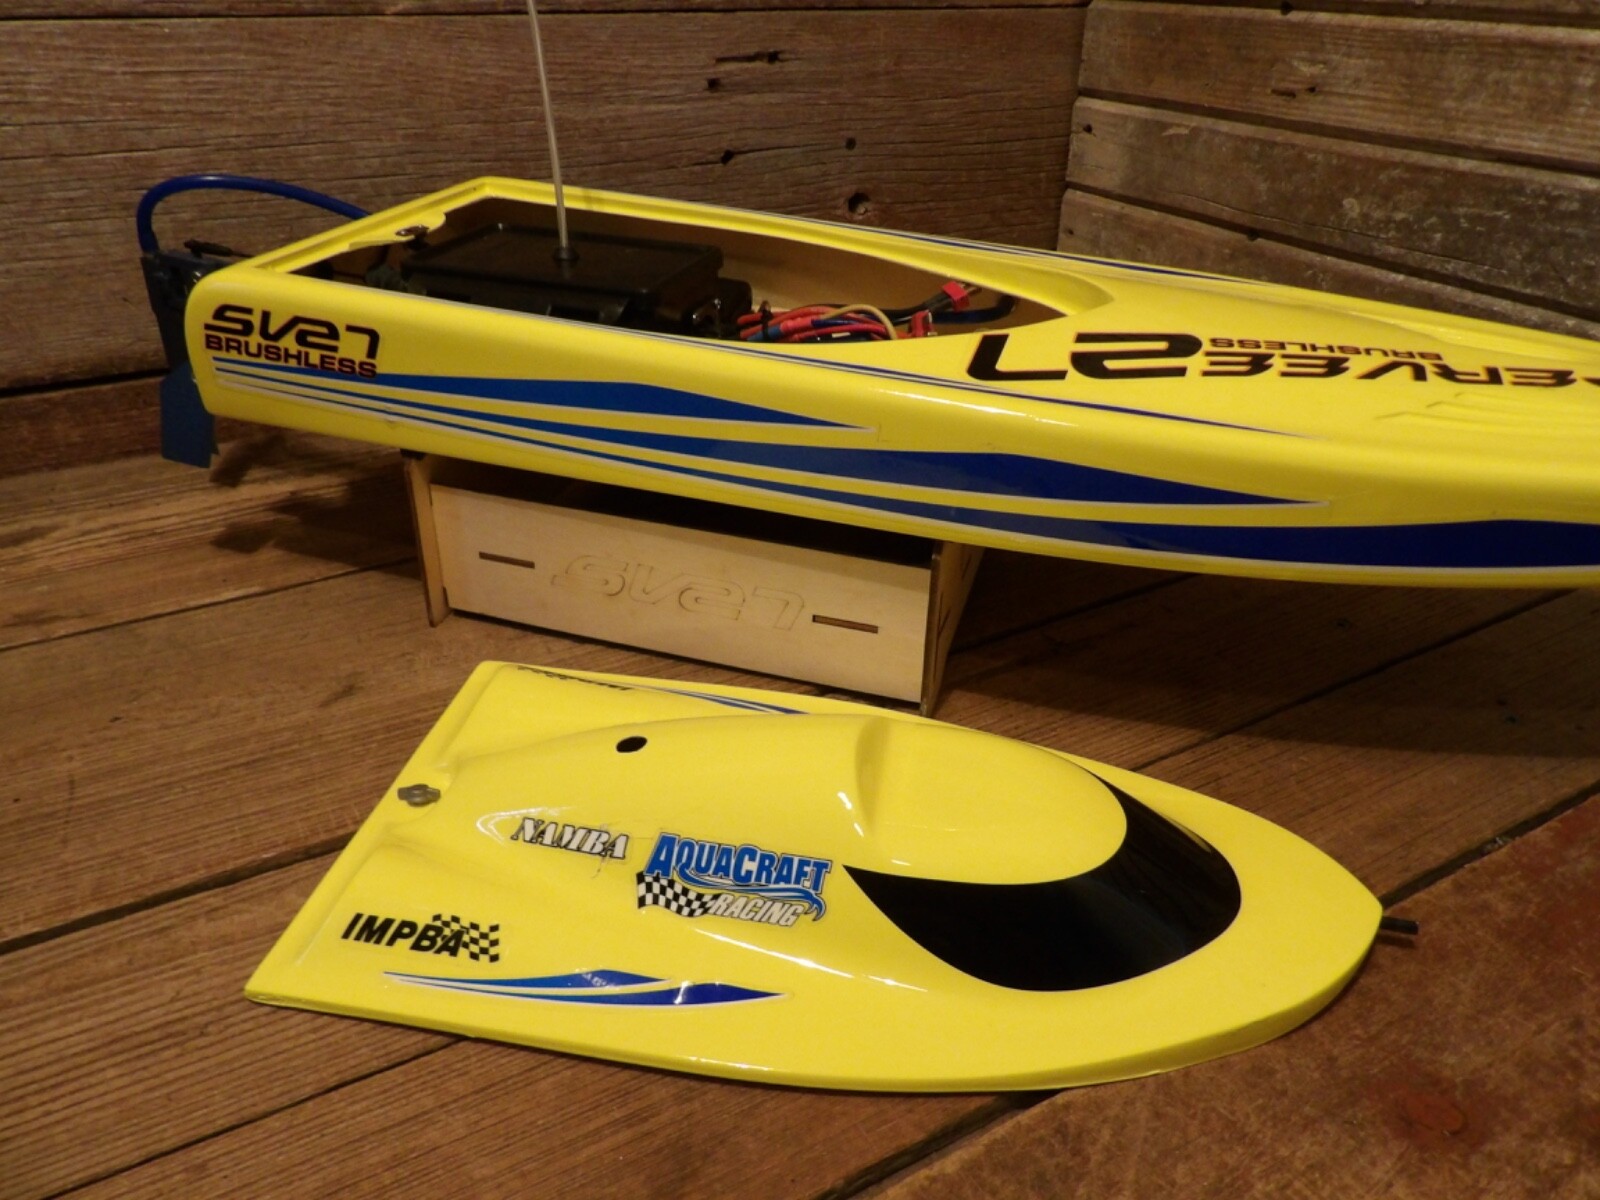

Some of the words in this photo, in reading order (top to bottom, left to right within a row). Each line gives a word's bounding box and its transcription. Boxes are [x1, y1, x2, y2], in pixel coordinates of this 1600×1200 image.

[204, 304, 380, 360] SV27
[1208, 337, 1443, 361] BRUSHLESS
[204, 333, 377, 378] BRUSHLESS
[1201, 351, 1600, 388] ERVEE
[551, 554, 804, 631] SV27
[511, 818, 629, 860] NAMBA
[708, 892, 804, 928] RACING
[341, 912, 465, 959] IMPBA
